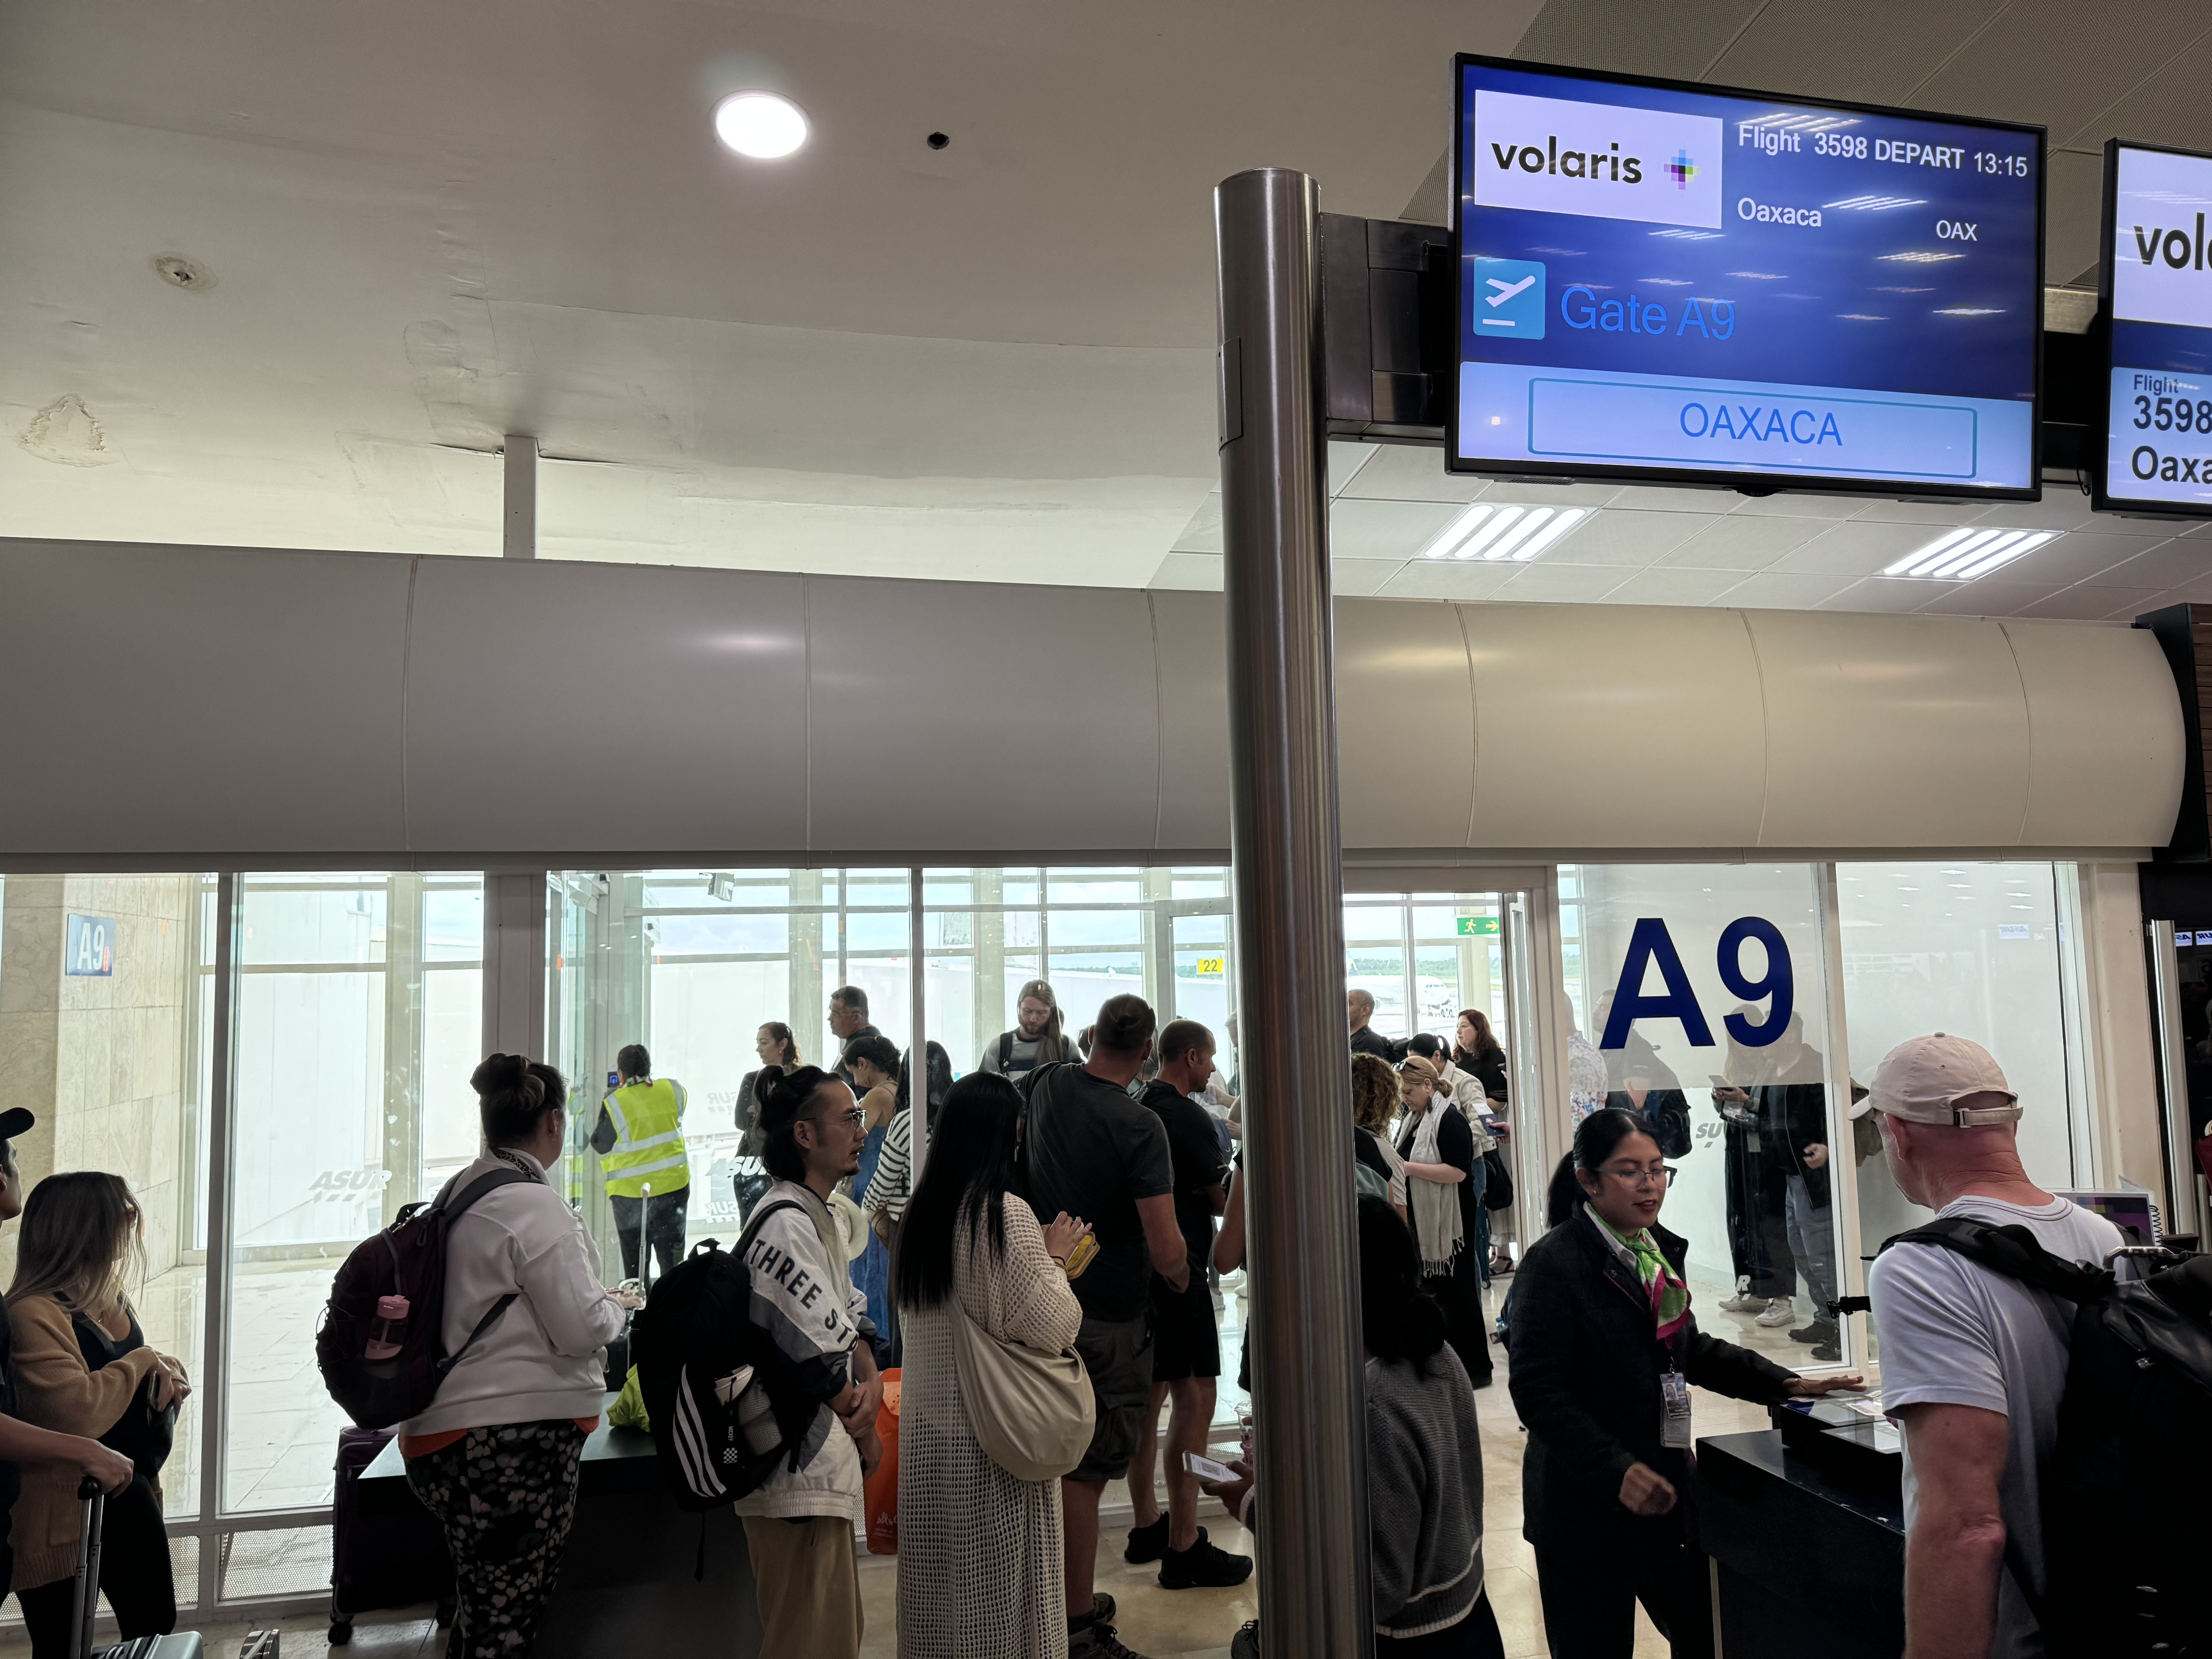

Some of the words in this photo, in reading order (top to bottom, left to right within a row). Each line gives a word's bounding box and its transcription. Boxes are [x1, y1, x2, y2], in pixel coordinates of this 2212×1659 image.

[1491, 135, 1642, 184] volaris
[1738, 124, 1801, 156] Flight
[1814, 132, 1868, 159] 3598
[1875, 139, 1965, 170] DEPART
[1973, 152, 2028, 177] 13:15
[1737, 197, 1822, 227] Oaxaca
[1936, 220, 1978, 241] OAX
[2133, 212, 2212, 271] vol
[1561, 285, 1667, 335] Gate
[1676, 296, 1735, 340] A9
[2134, 374, 2179, 396] Flight
[1680, 402, 1843, 447] OAXACA
[2133, 395, 2212, 434] 3598
[76, 922, 105, 970] A9
[1204, 959, 1218, 972] 22
[1599, 915, 1794, 1050] A9
[308, 1170, 392, 1190] ASUR
[750, 1238, 823, 1310] THREE
